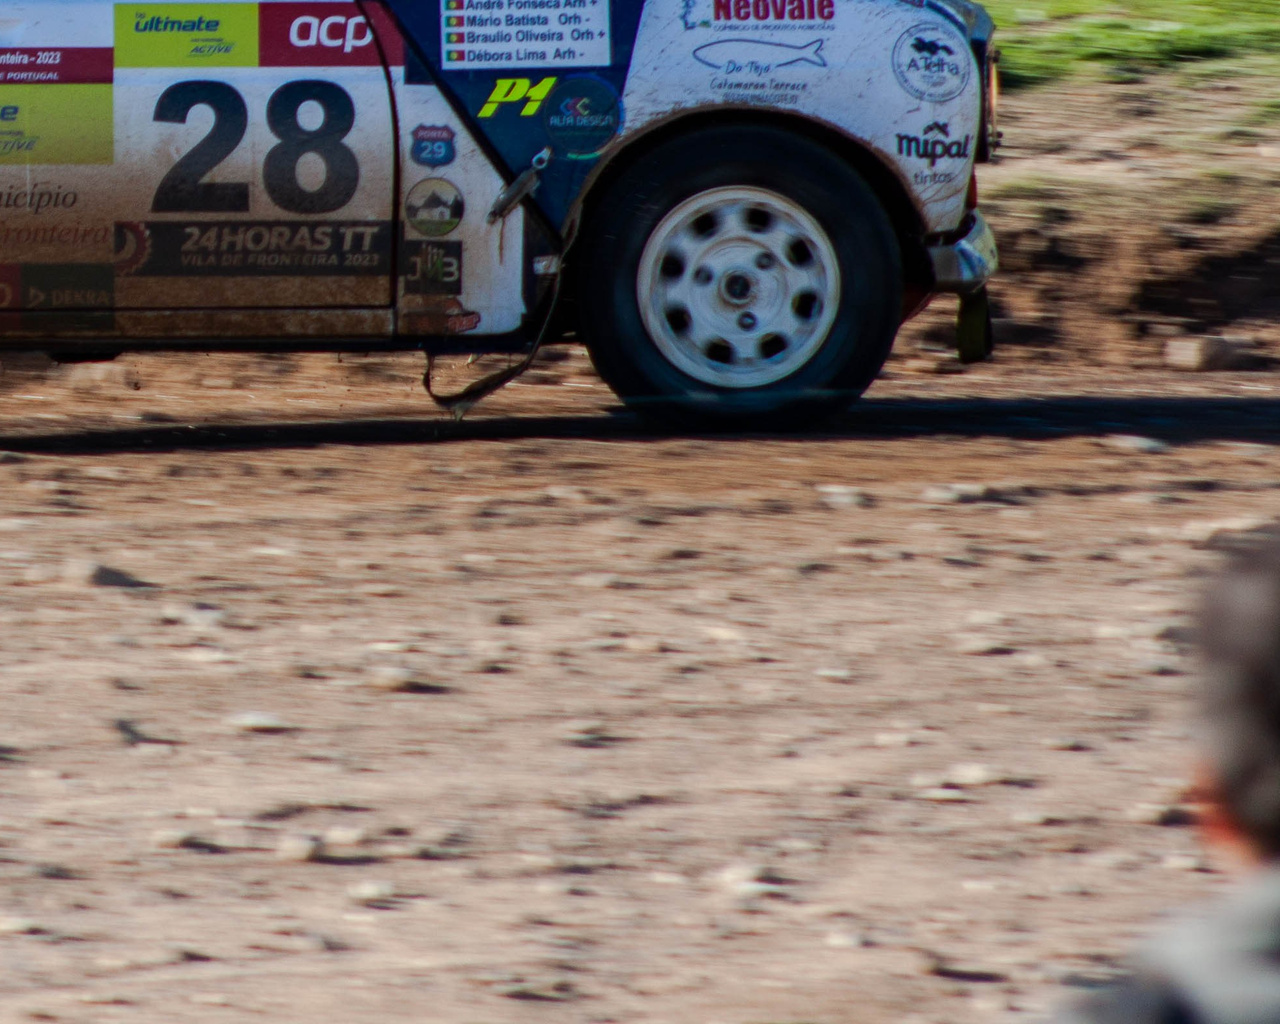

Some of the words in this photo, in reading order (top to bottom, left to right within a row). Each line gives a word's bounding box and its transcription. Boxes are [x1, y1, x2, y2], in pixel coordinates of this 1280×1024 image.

[134, 16, 220, 32] ultimate
[466, 13, 501, 27] Mário
[505, 13, 549, 25] Batista
[289, 15, 373, 53] acp
[515, 29, 564, 42] Oliveira
[36, 52, 61, 64] 2023
[467, 48, 512, 62] Débora
[516, 49, 547, 61] Lima
[553, 48, 576, 60] Arh
[7, 71, 59, 80] PORTUGAL
[150, 79, 360, 215] 28
[420, 141, 446, 159] 29
[895, 133, 971, 168] mipal
[913, 170, 954, 186] tintas
[247, 253, 339, 266] FRONTEIRA
